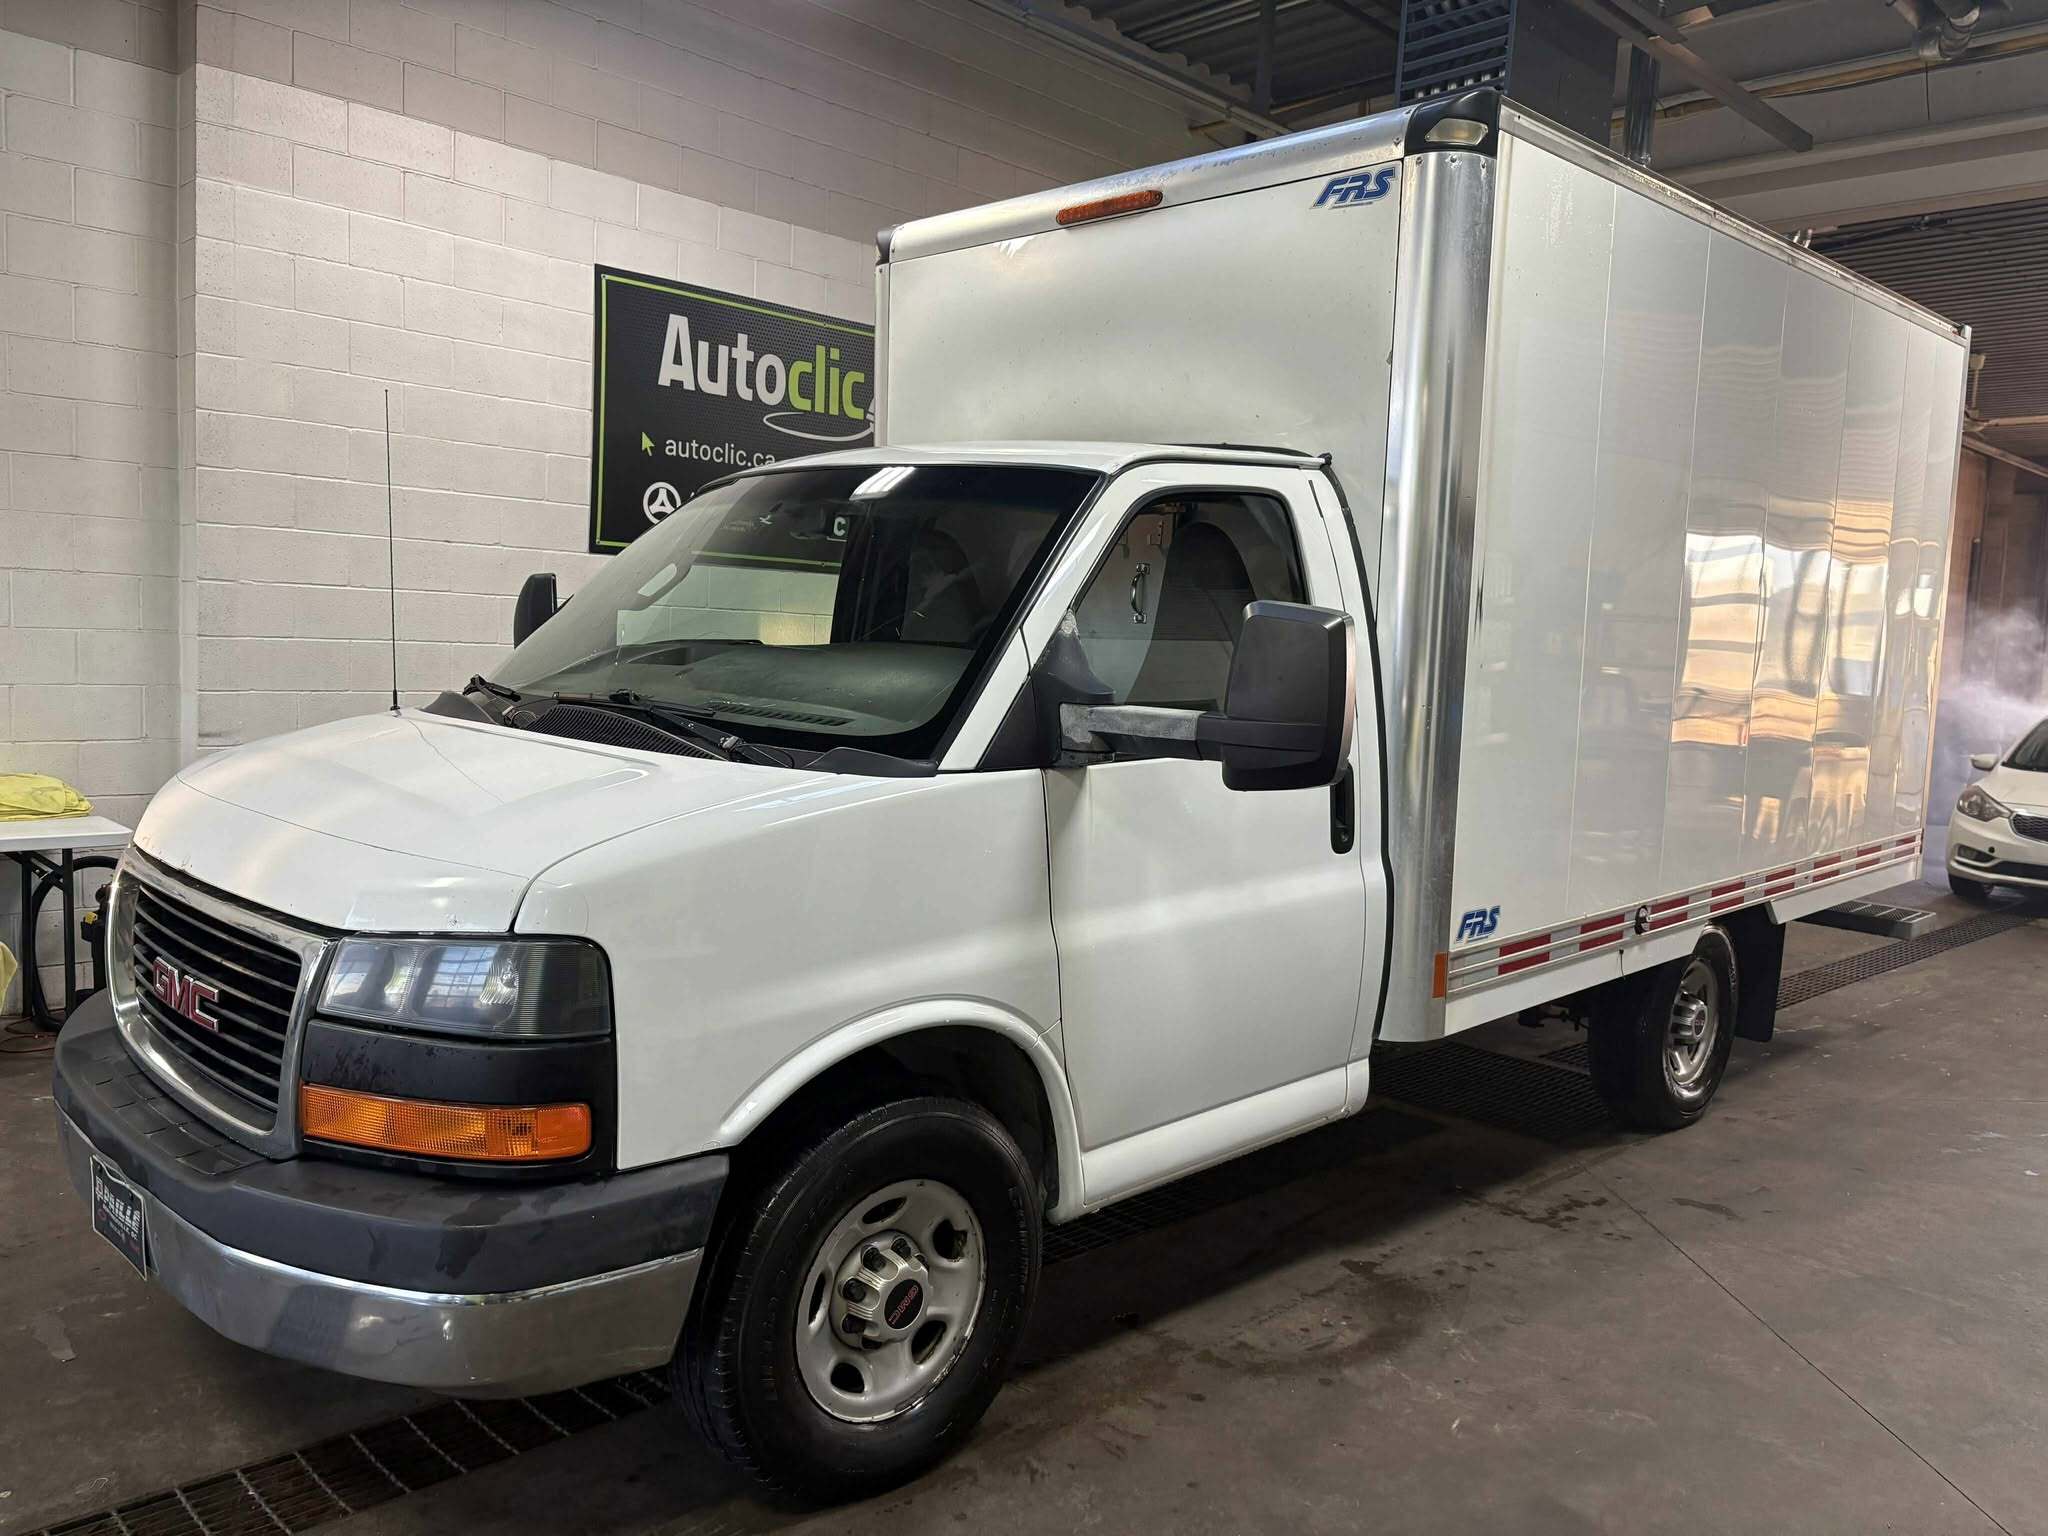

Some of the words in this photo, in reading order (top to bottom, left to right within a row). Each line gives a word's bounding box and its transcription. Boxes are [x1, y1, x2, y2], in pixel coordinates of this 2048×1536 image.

[1312, 167, 1395, 208] FRS
[657, 313, 865, 420] Autoclic
[664, 438, 776, 467] autoclic.ca
[1456, 905, 1500, 941] FRS
[153, 956, 219, 1032] GMC
[888, 1284, 920, 1326] GMC
